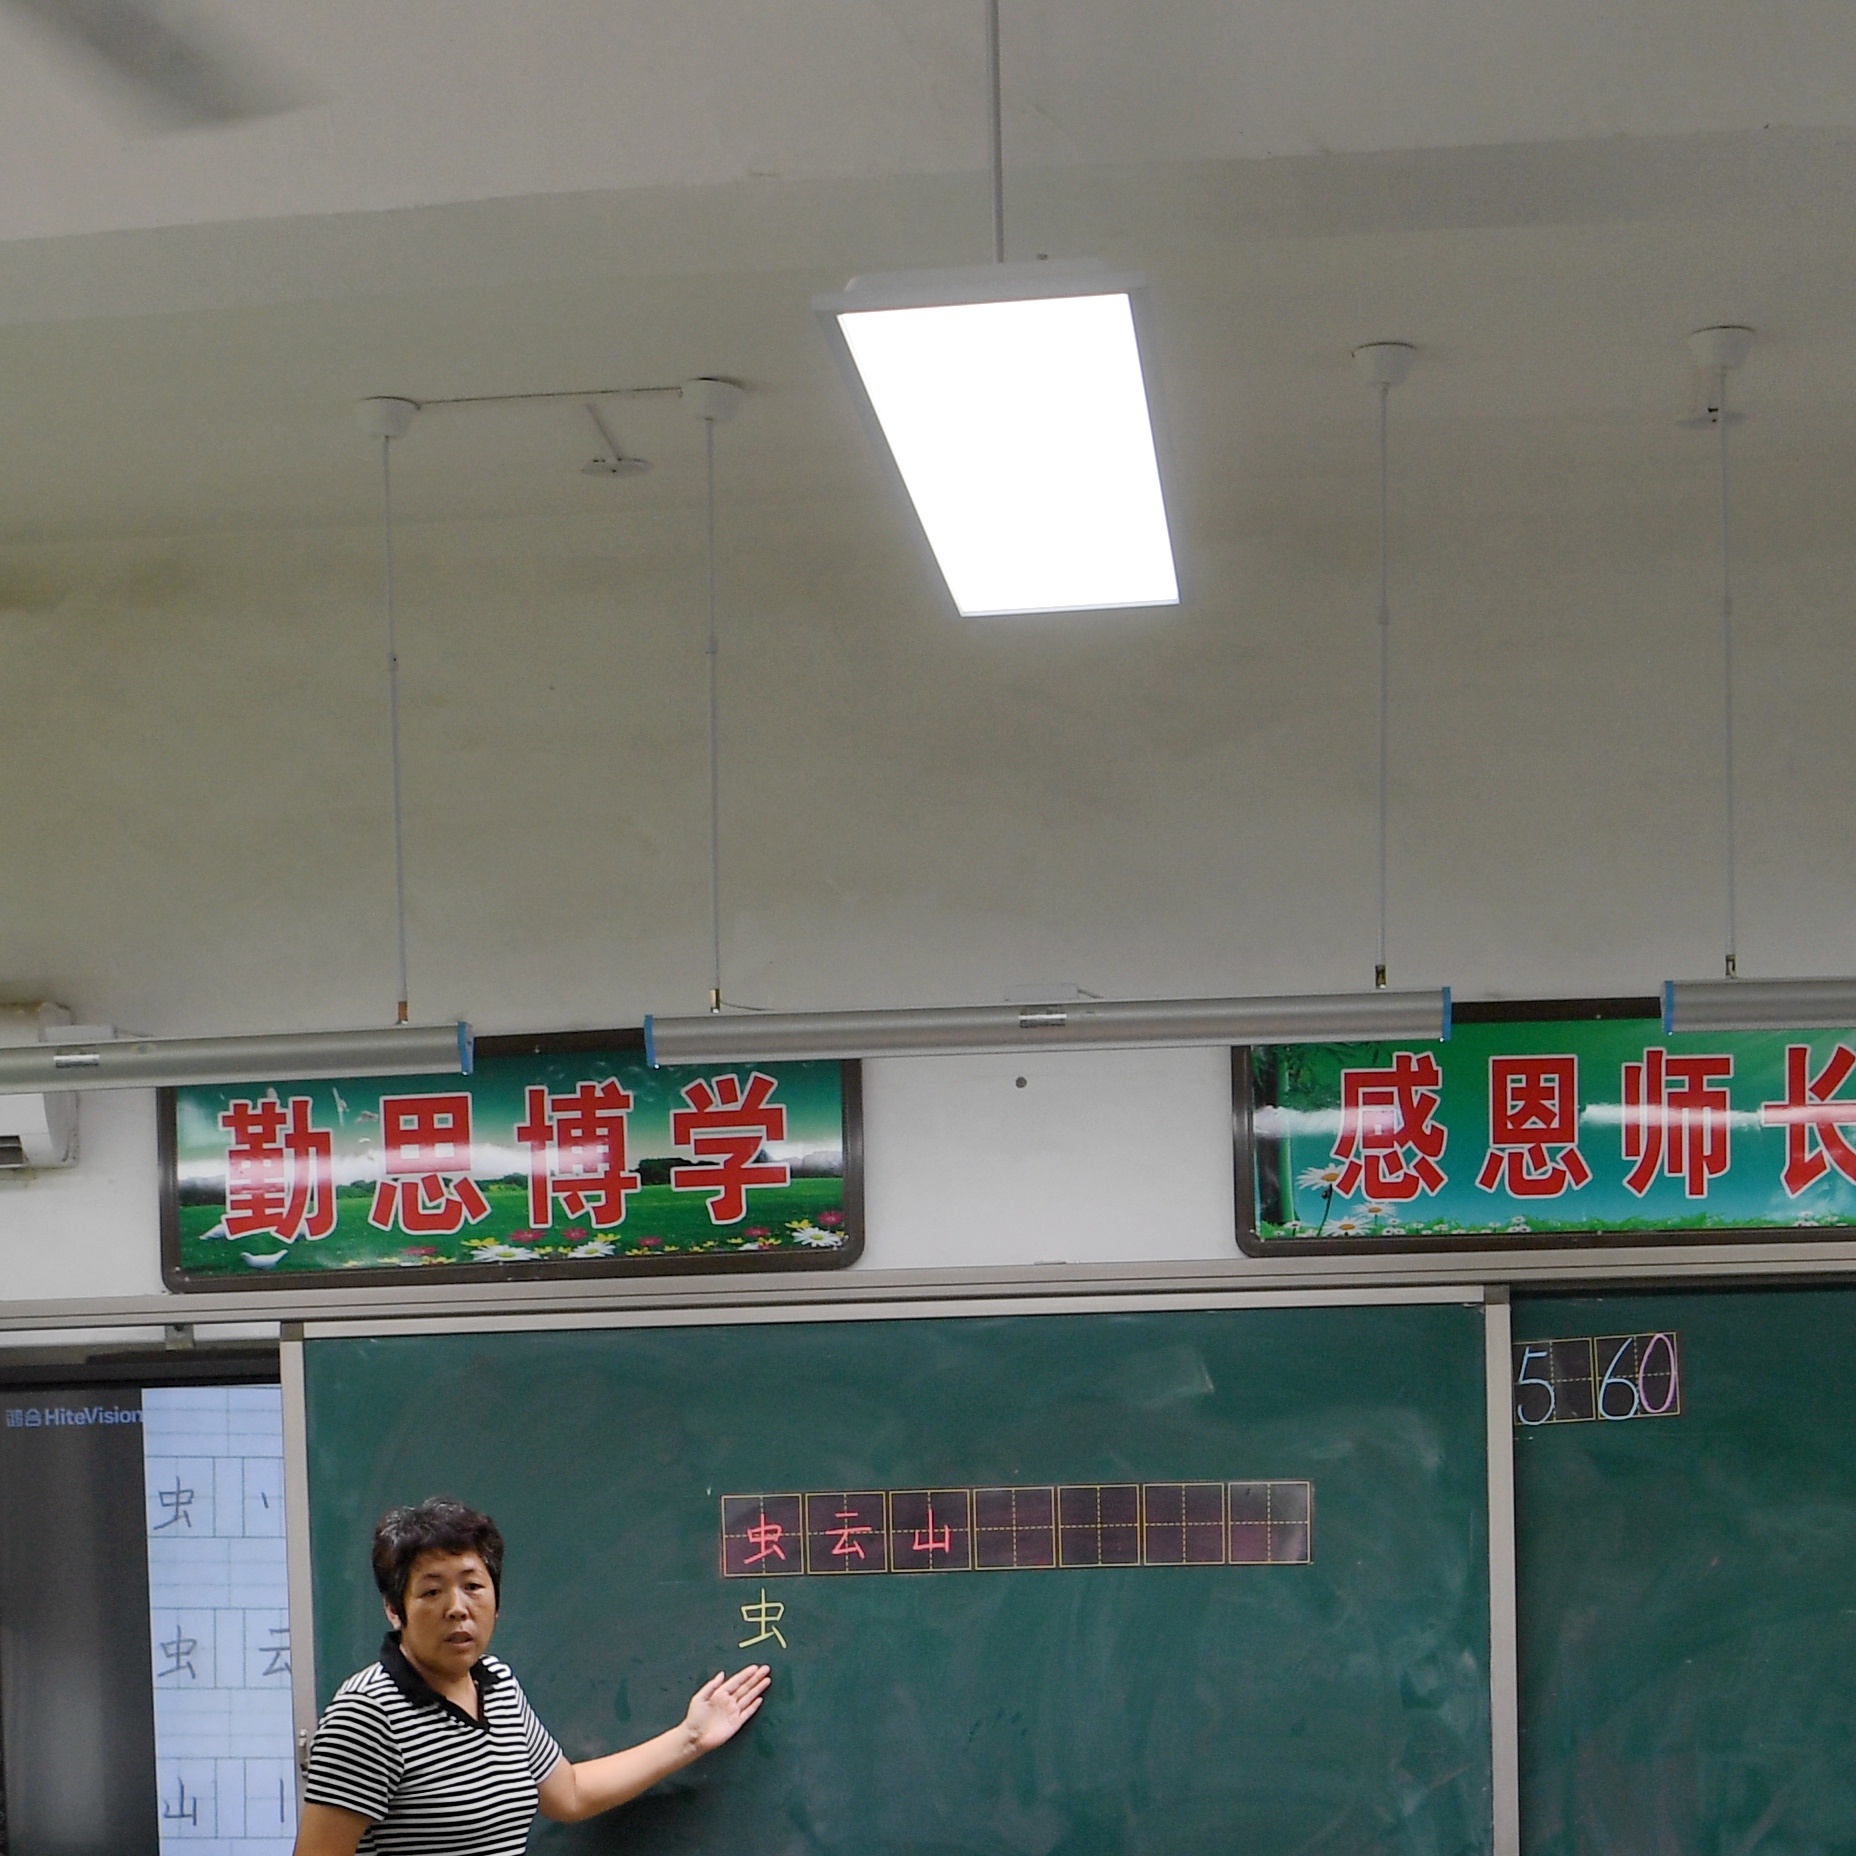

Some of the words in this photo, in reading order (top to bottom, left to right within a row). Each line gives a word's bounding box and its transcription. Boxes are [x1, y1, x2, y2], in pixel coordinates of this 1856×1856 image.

[218, 1072, 792, 1241] 勤思博学
[1517, 1345, 1556, 1426] 5
[1598, 1333, 1679, 1421] 60
[45, 1406, 143, 1425] HiteVision
[154, 1476, 196, 1531] 虫
[738, 1588, 787, 1650] 虫
[157, 1624, 198, 1680] 虫
[162, 1778, 198, 1826] 山
